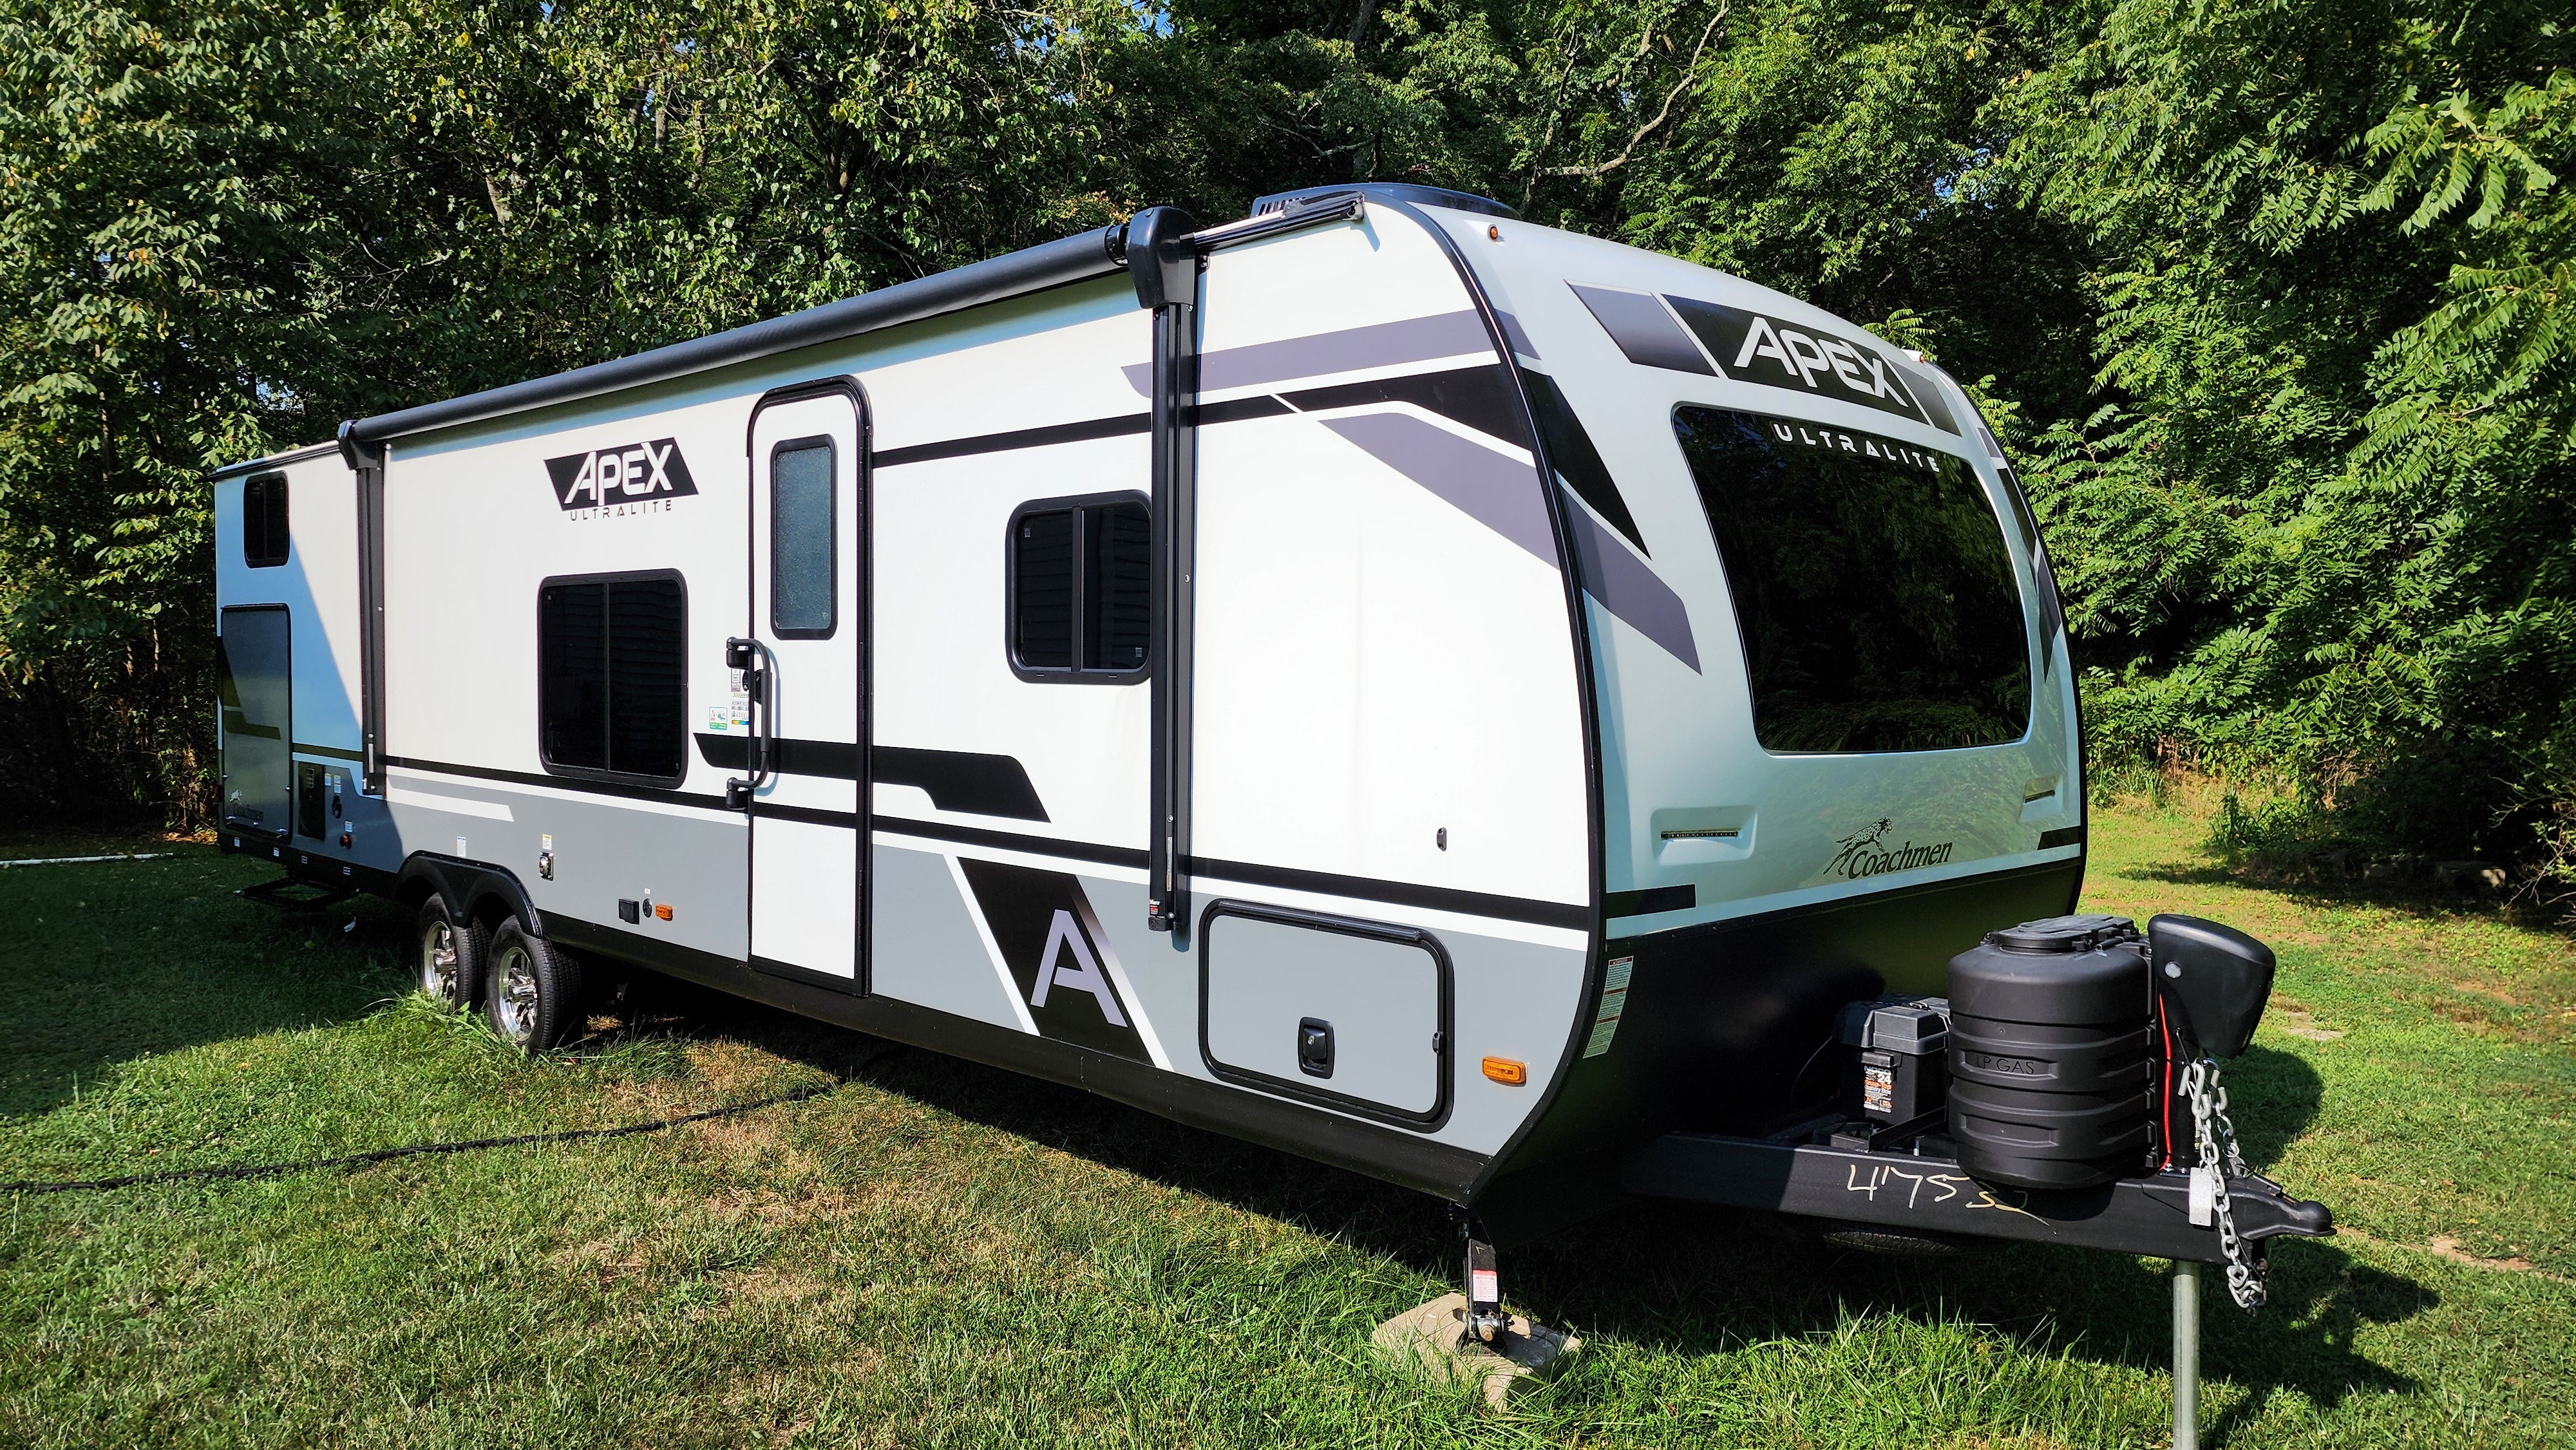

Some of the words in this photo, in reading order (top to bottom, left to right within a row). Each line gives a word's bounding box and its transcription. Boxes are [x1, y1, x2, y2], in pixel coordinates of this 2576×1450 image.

[1734, 316, 1909, 408] APEX
[1774, 423, 1940, 473] ULTRALITE
[564, 442, 673, 506] APEX
[570, 500, 672, 522] ULTRALITE
[1848, 840, 1953, 880] Coachmen
[1030, 909, 1128, 1028] A
[1878, 1073, 1892, 1085] 24
[1976, 1053, 1991, 1069] LP
[1996, 1057, 2035, 1075] GAS
